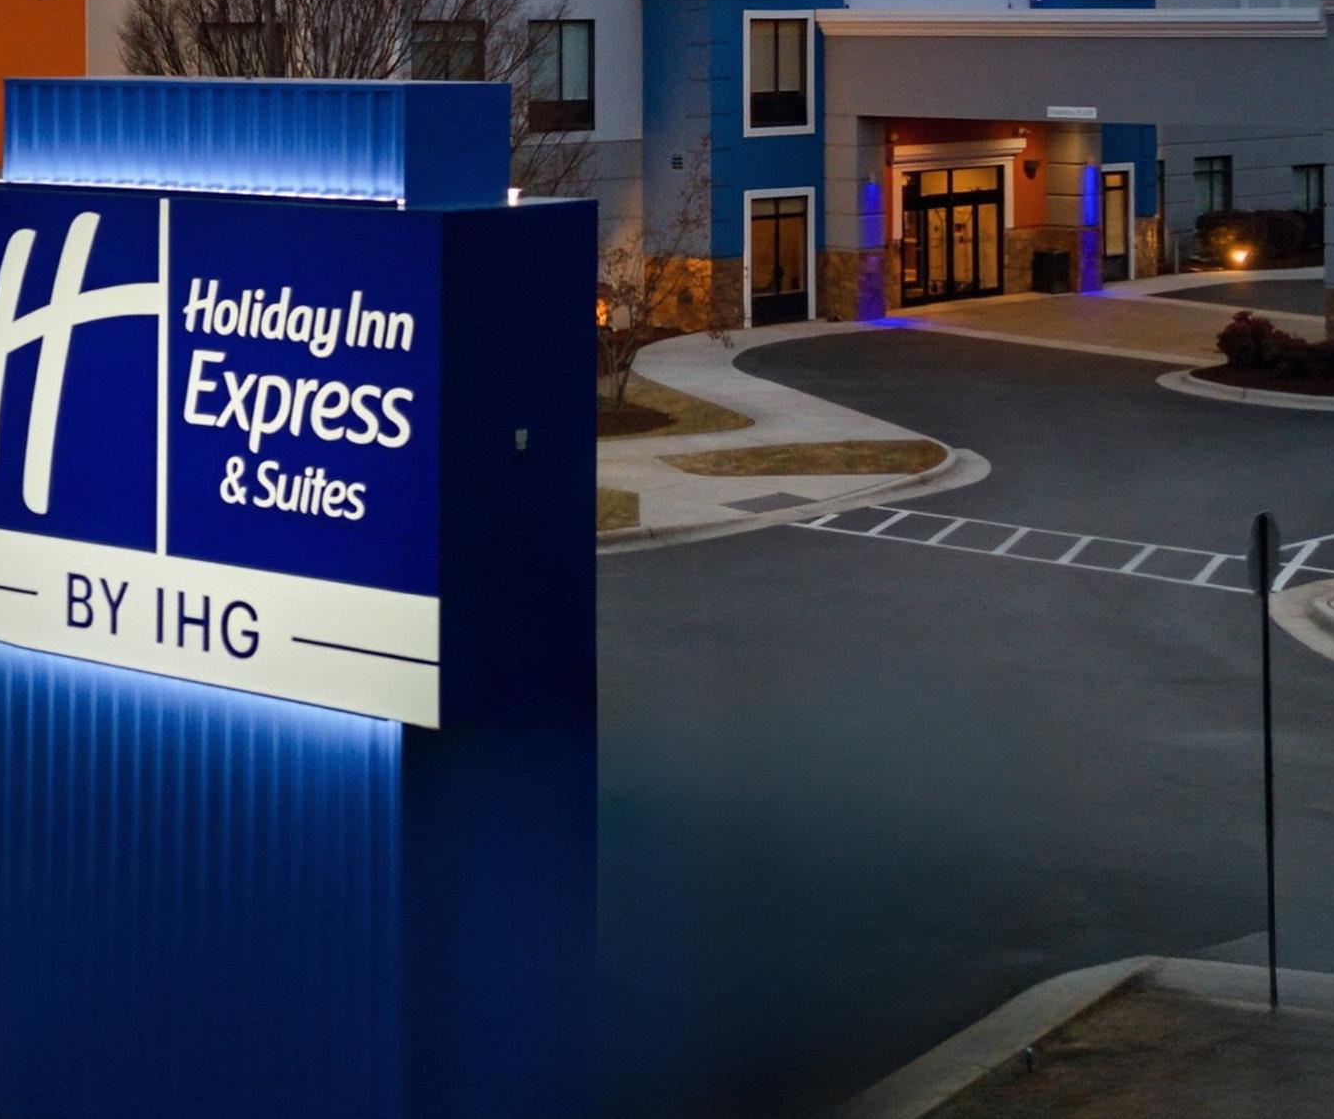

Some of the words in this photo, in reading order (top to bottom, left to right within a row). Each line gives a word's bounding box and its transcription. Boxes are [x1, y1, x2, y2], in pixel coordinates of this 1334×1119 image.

[183, 277, 342, 358] Holiday
[345, 290, 415, 352] Inn
[183, 349, 415, 454] Express
[219, 455, 247, 506] &
[252, 460, 367, 521] Suites
[66, 572, 130, 636] BY
[155, 587, 261, 660] IHG
